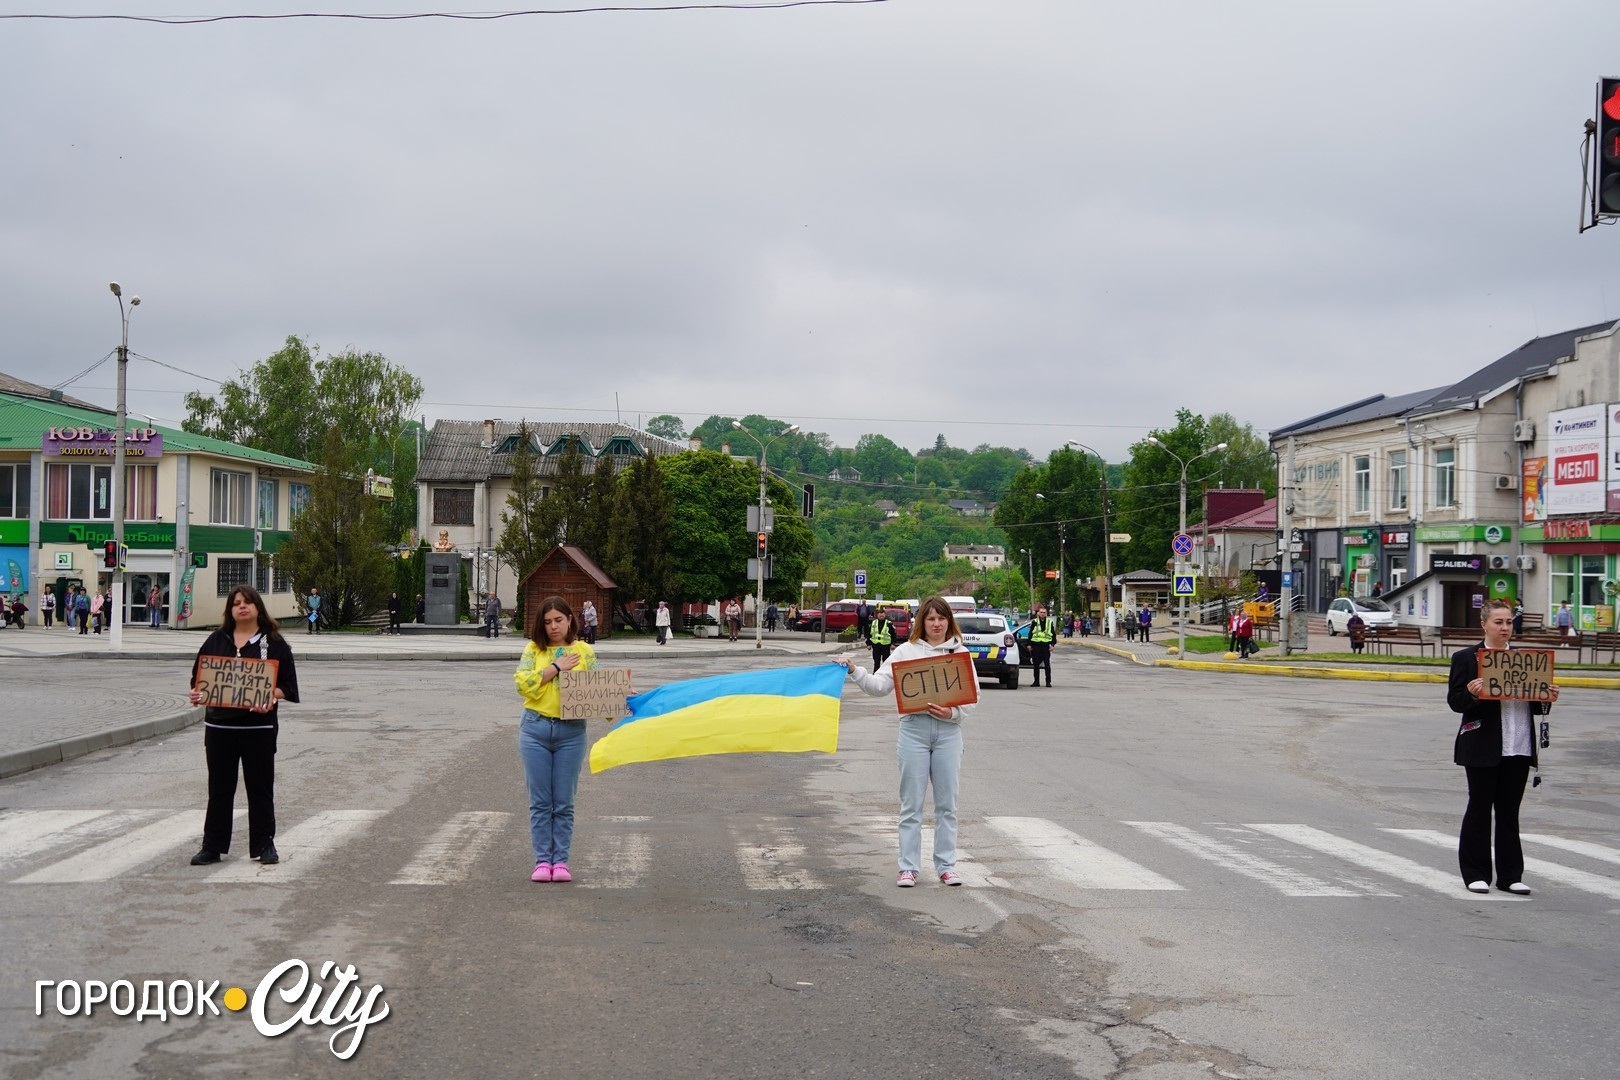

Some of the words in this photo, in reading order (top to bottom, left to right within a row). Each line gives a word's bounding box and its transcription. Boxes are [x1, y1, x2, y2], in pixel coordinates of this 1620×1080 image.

[60, 447, 95, 456] ЗОЛОТО
[98, 447, 109, 456] ТА
[112, 447, 145, 456] СБЛО
[1557, 460, 1596, 480] МЕБЛІ
[86, 530, 174, 543] ПриатБанк
[1543, 520, 1591, 539] АПТЕКА
[200, 657, 266, 674] ВШАНУЙ
[1482, 650, 1548, 672] ЗГАДАЙ
[214, 671, 272, 689] ПАМЯТЬ
[561, 668, 632, 689] ЗУПИНИСЬ!
[901, 658, 962, 698] СТІЙ
[1503, 670, 1528, 682] ПРО
[567, 687, 625, 702] ХВИЛИНА
[1489, 677, 1550, 700] ВОЇНІВ
